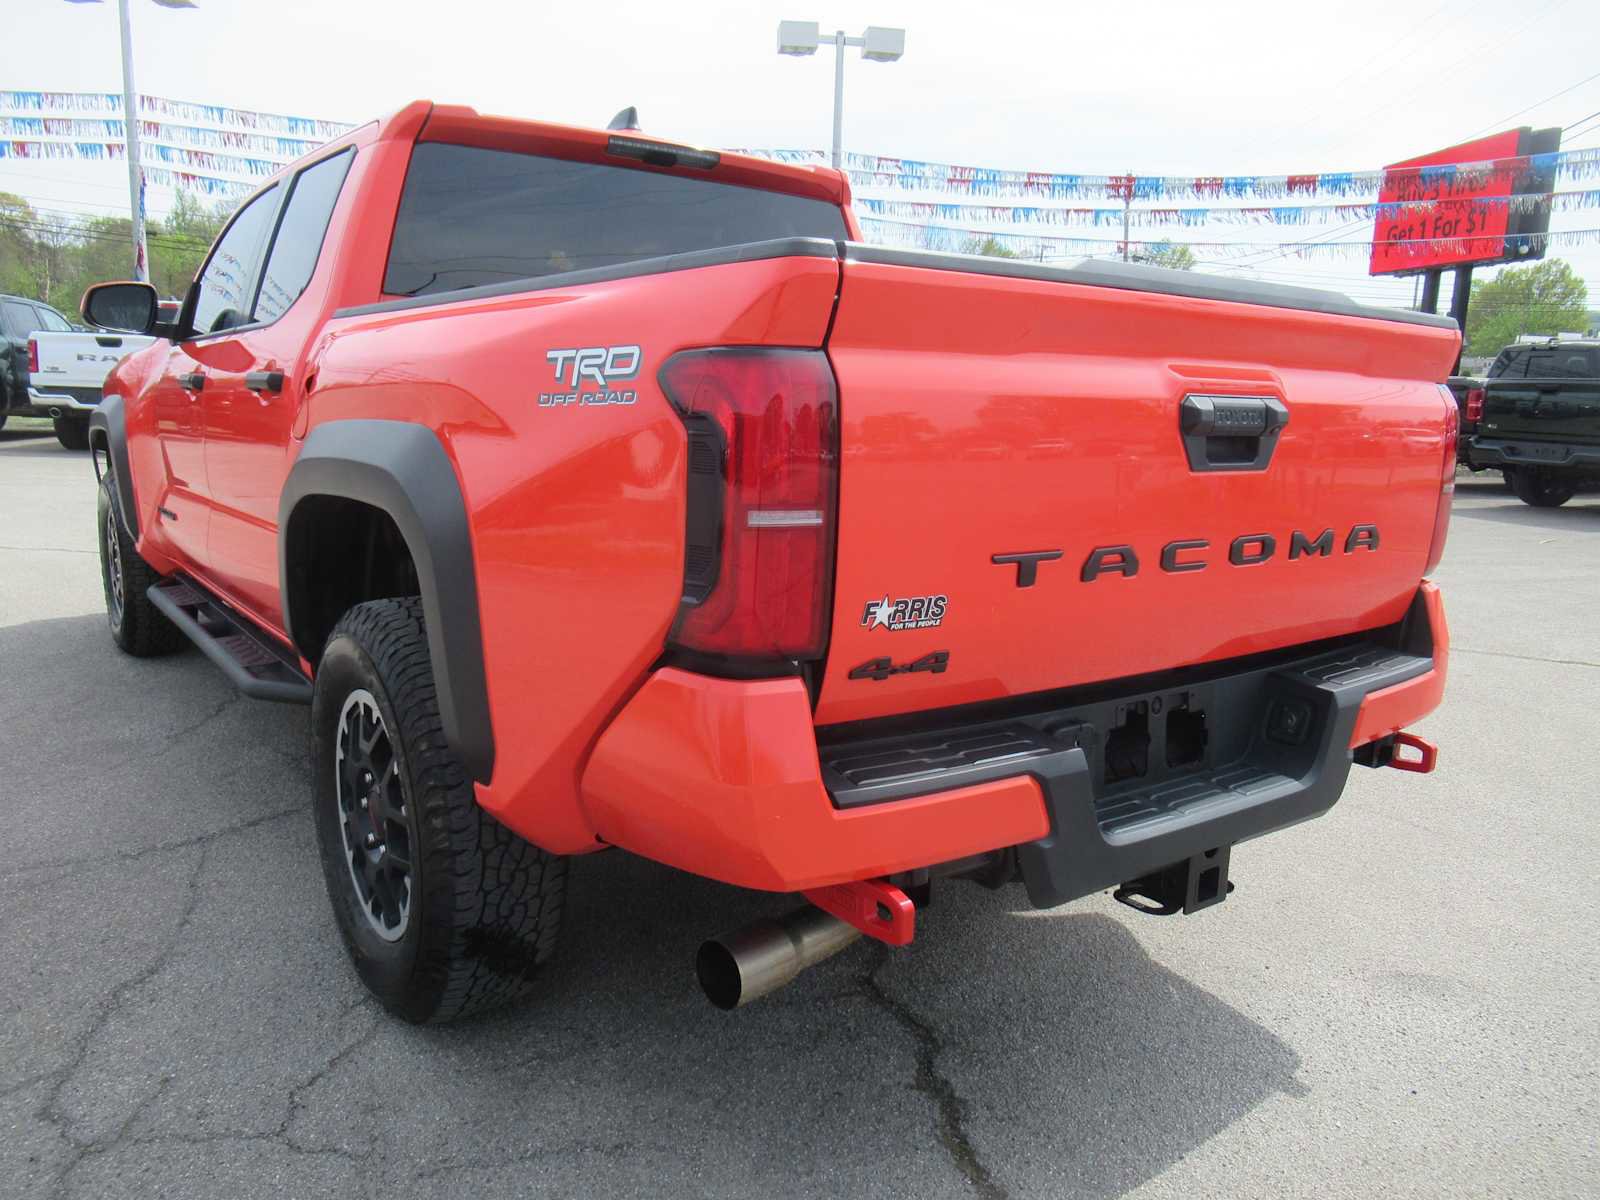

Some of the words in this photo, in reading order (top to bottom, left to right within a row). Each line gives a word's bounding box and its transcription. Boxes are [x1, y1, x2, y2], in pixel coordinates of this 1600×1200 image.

[1387, 223, 1415, 246] Get
[1433, 213, 1461, 239] For
[77, 353, 119, 362] RA
[546, 345, 642, 389] TRD
[538, 393, 578, 407] OFF
[578, 392, 637, 406] ROAD
[1216, 409, 1264, 425] TOYOTA
[991, 524, 1381, 588] TACOMA
[891, 622, 903, 630] FOR
[918, 619, 941, 627] PEOPLE
